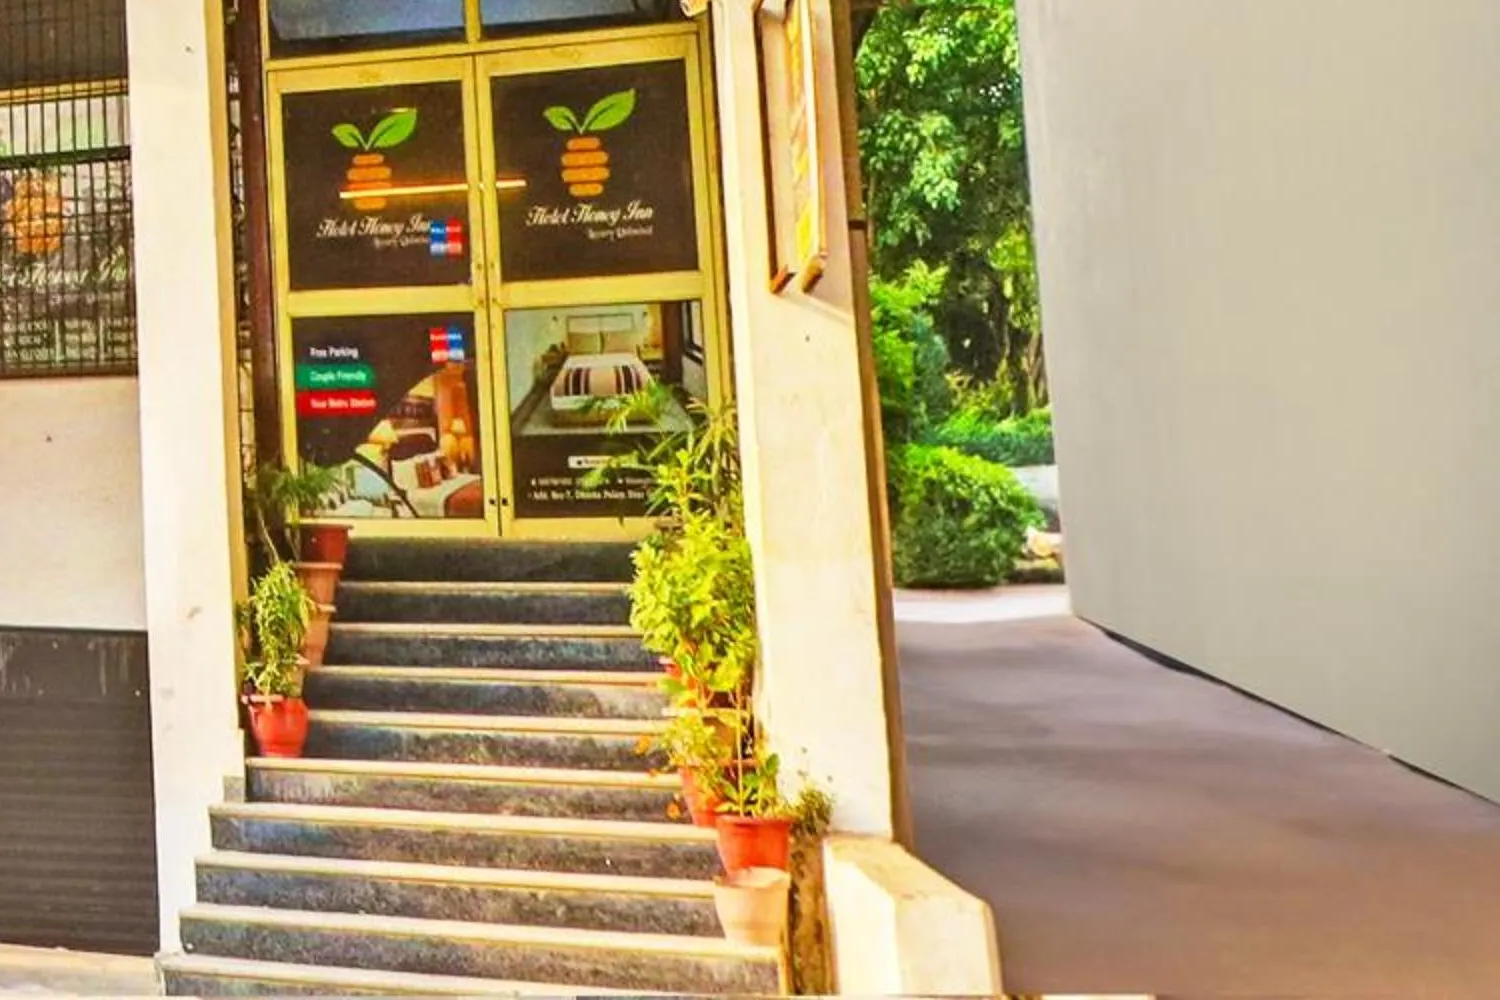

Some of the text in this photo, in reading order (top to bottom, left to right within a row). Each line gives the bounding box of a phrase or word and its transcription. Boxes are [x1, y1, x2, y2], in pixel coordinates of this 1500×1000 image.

[525, 200, 654, 227] Hotel Honey Inn
[316, 218, 357, 238] Hotel
[357, 216, 405, 236] Honey
